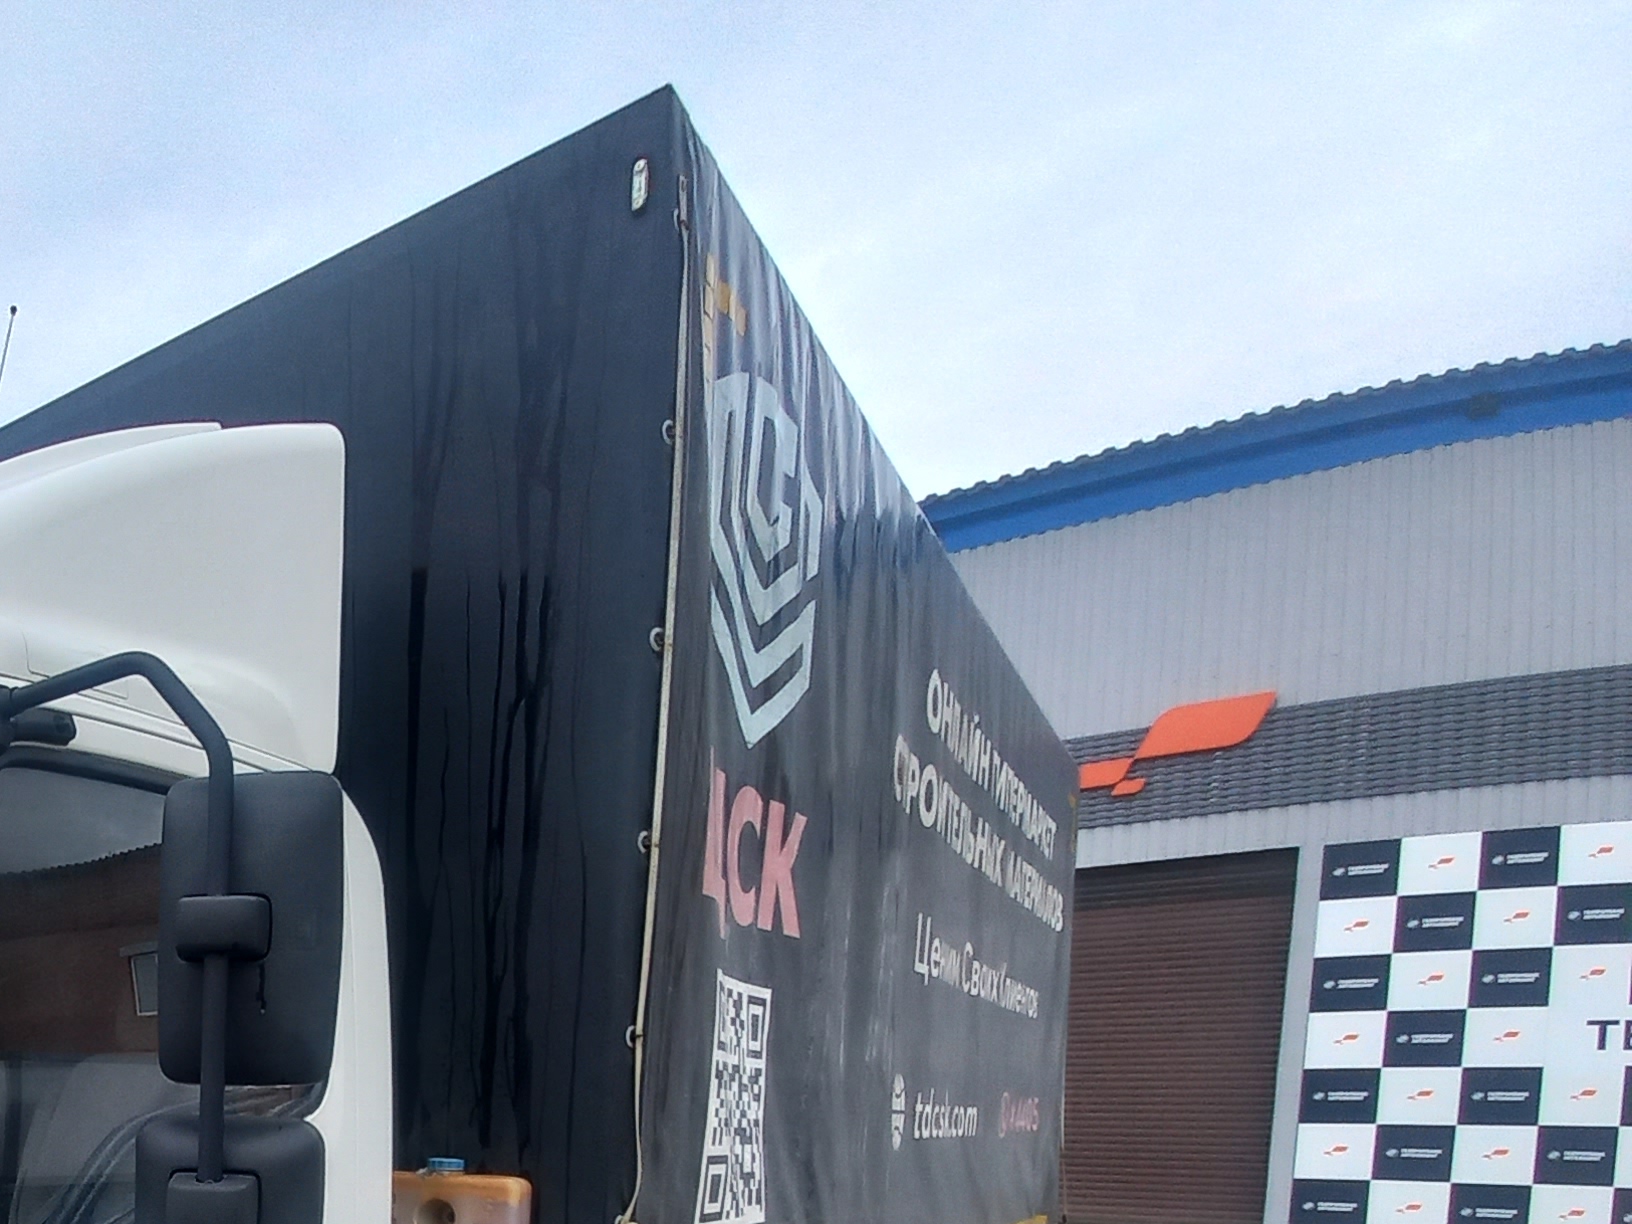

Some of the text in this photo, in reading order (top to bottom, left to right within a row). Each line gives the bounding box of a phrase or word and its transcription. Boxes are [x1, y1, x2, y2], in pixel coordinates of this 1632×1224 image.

[926, 668, 993, 792] ОНЛАЙН
[702, 746, 808, 941] ЦСК
[913, 1087, 979, 1140] tdcsk.com
